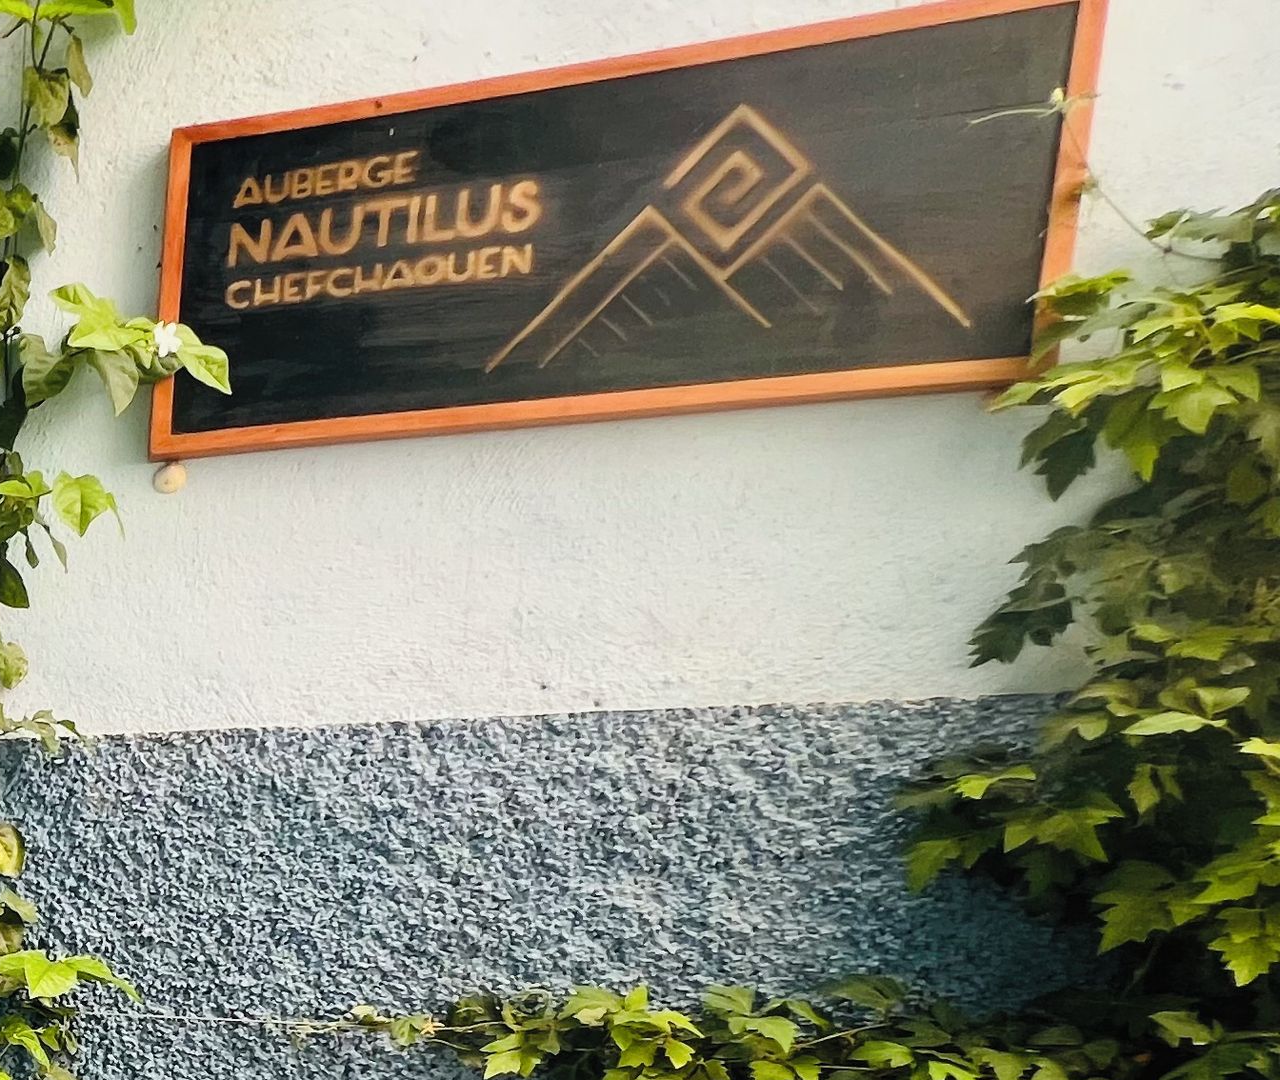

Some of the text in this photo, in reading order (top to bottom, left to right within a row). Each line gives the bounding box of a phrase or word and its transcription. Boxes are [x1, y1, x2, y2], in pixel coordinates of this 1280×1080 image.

[232, 150, 420, 209] AUBERGE
[226, 180, 542, 268] NAUTILUS
[224, 244, 535, 310] CHEFCHAOUEN
